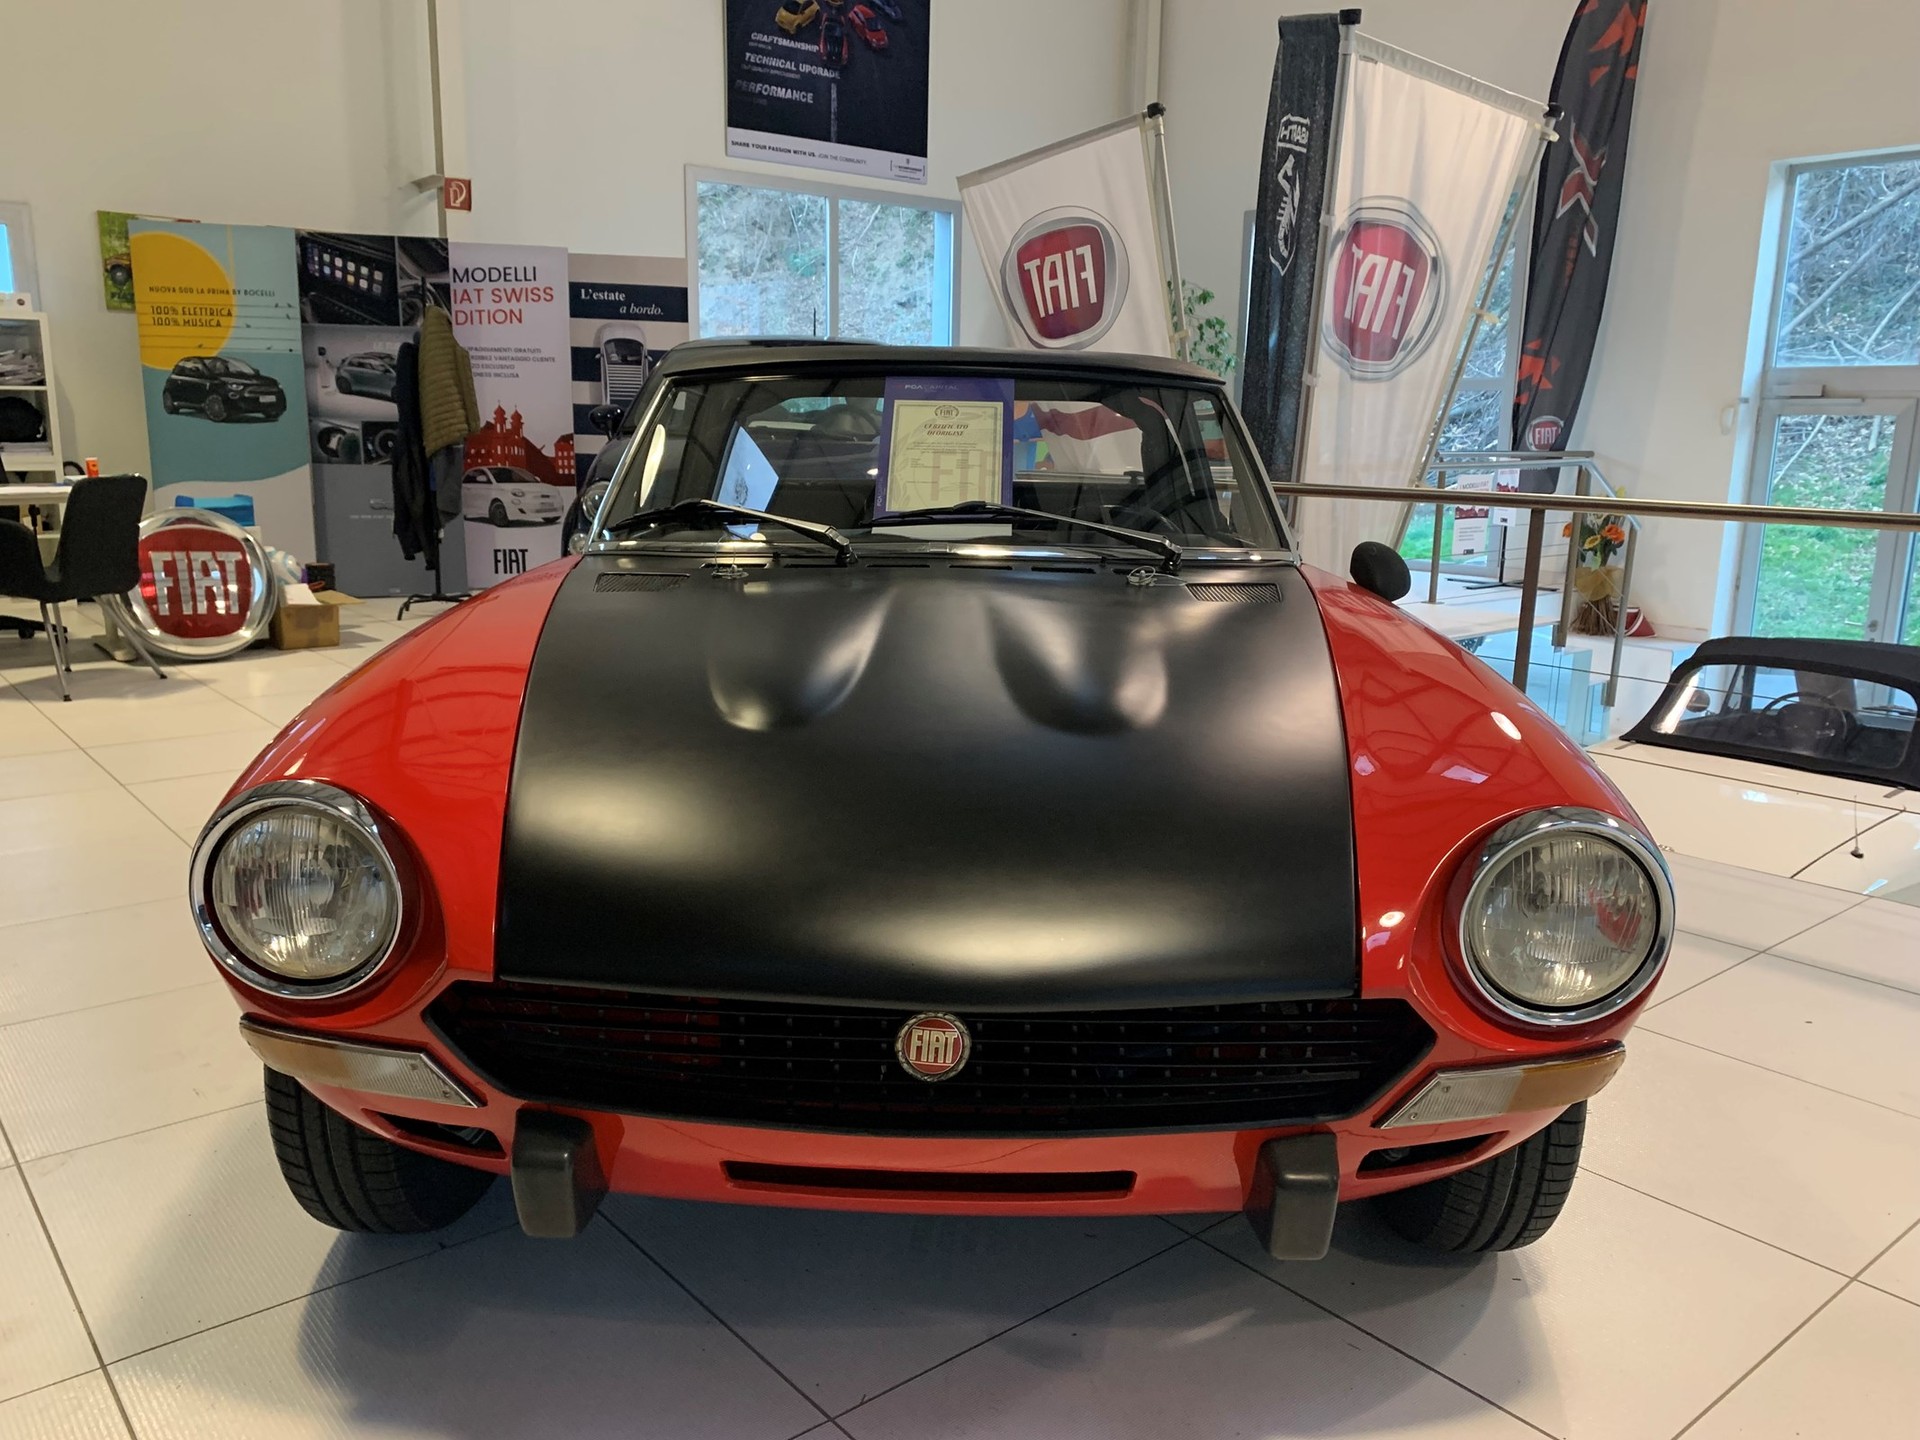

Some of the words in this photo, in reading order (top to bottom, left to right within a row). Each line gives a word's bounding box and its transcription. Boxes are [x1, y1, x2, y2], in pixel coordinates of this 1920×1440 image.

[751, 32, 820, 52] CRAFTSMANSHIP
[745, 52, 796, 71] TECHNICAL
[798, 63, 841, 80] UPGRADE
[735, 79, 814, 104] PERFORMANCE
[731, 140, 750, 148] SHARE
[768, 145, 792, 154] PASSION
[793, 149, 807, 157] WITH
[452, 266, 537, 283] MODELLI
[149, 286, 176, 294] NUOVA
[207, 288, 230, 296] PRIMA
[244, 289, 276, 297] BOCELLI
[453, 288, 484, 304] IAT
[491, 286, 554, 304] SWISS
[580, 288, 626, 301] L'estate
[151, 306, 179, 316] 100%
[182, 306, 233, 317] ELETTRICA
[455, 308, 523, 326] DITION
[619, 305, 627, 314] a
[629, 303, 664, 316] bordo.
[152, 316, 180, 327] 100%
[183, 318, 222, 328] MUSICA
[1535, 426, 1557, 445] FIAT
[493, 549, 528, 574] FIAT
[149, 551, 242, 615] FIAT
[910, 1028, 958, 1063] FIAT
